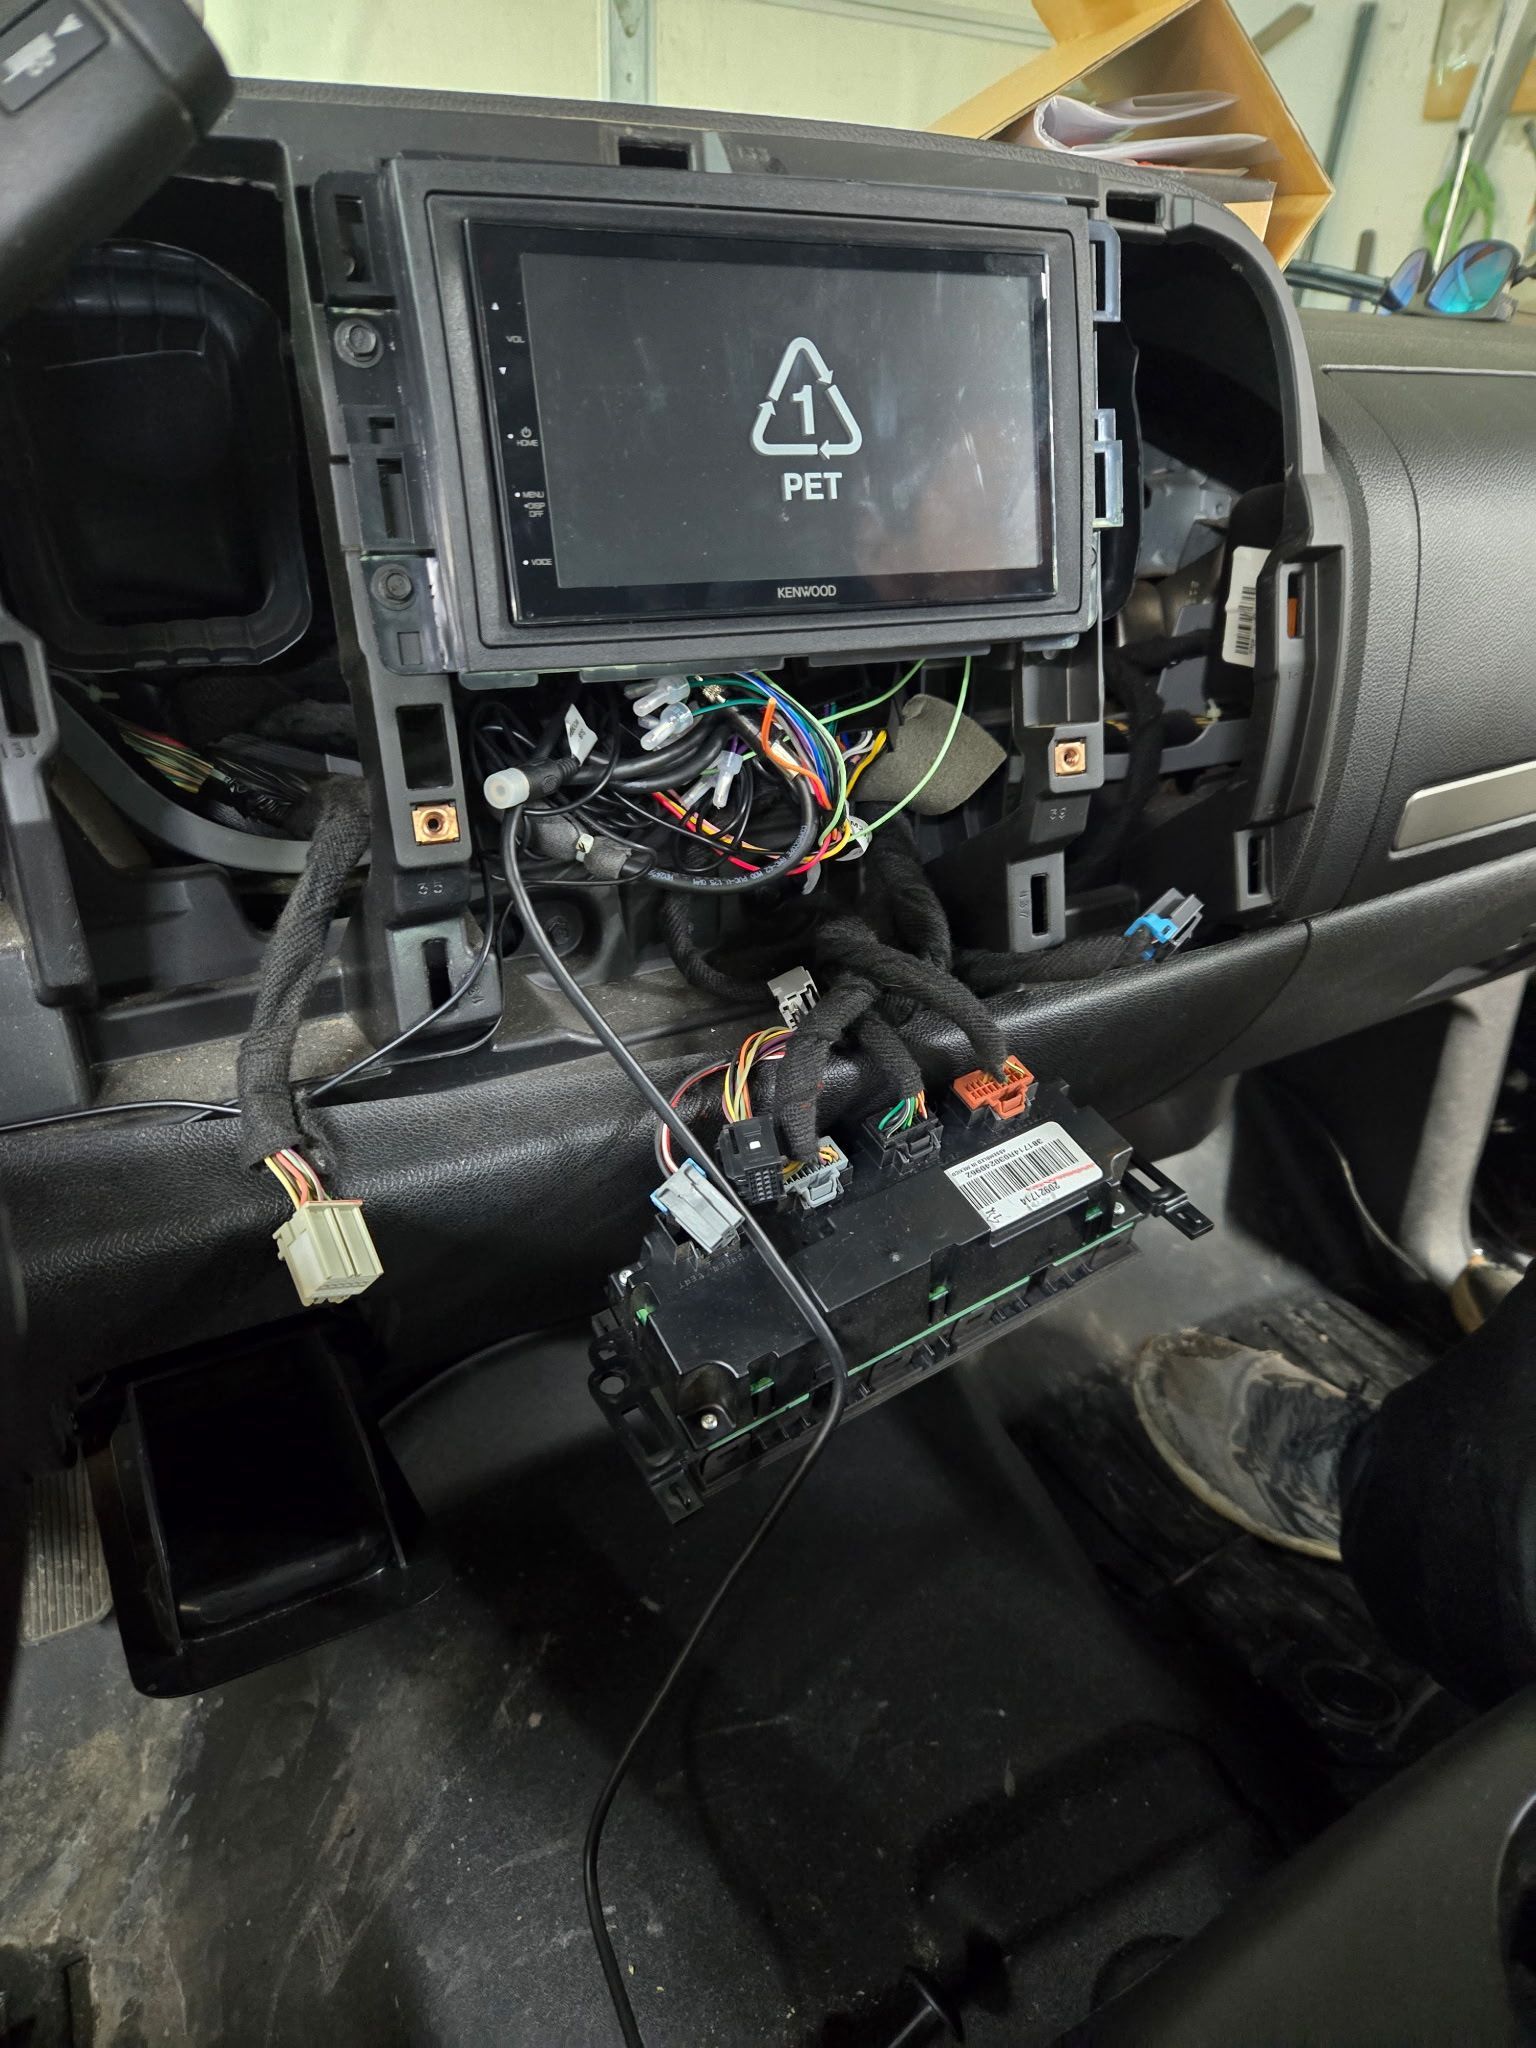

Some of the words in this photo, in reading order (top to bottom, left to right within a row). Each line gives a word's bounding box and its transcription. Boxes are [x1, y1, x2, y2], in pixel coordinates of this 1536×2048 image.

[505, 335, 525, 343] VOL
[792, 384, 815, 435] 1
[516, 439, 539, 447] HOME
[782, 471, 842, 501] PET
[531, 558, 553, 566] VOICE
[777, 585, 837, 600] KENWOOD
[1019, 1181, 1060, 1206] 20921714
